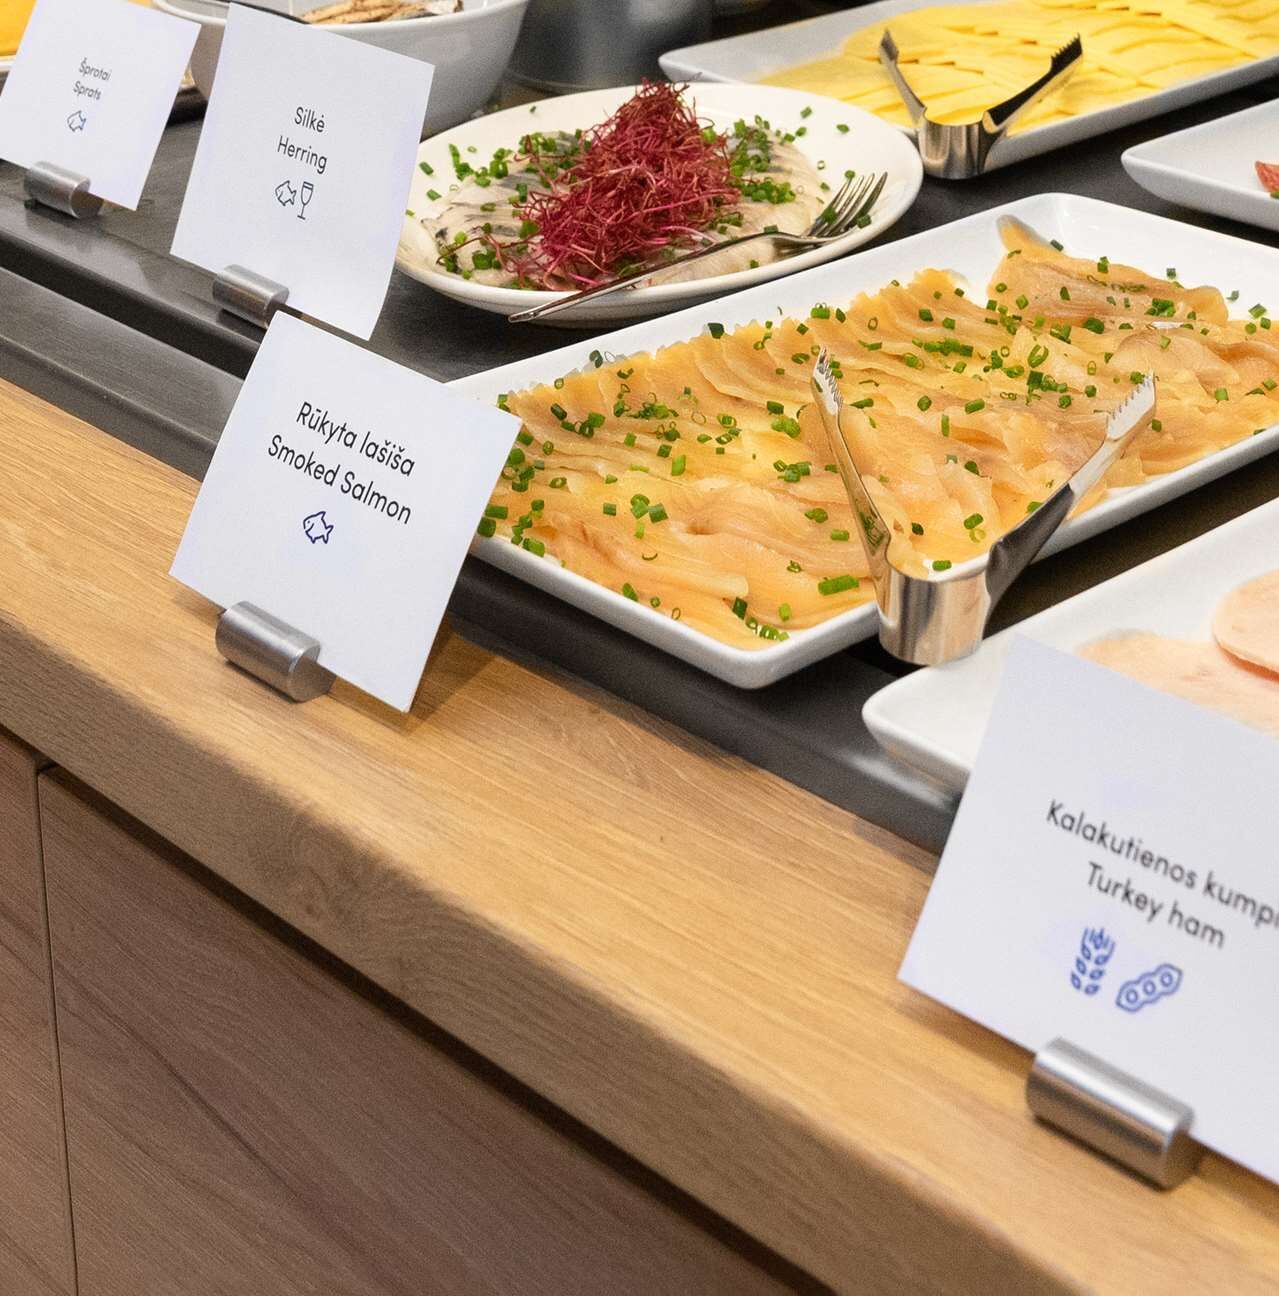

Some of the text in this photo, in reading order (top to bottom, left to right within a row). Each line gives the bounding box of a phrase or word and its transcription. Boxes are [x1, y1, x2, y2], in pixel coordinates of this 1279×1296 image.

[73, 80, 102, 101] Sprats
[78, 57, 112, 81] Šprotai
[294, 106, 325, 133] Silkė
[277, 135, 327, 174] Herring
[296, 401, 416, 477] Rūkyta lašiša
[268, 434, 412, 524] Smoked Salmon
[1046, 799, 1199, 890] Kalakutienos
[1086, 860, 1226, 950] Turkey ham
